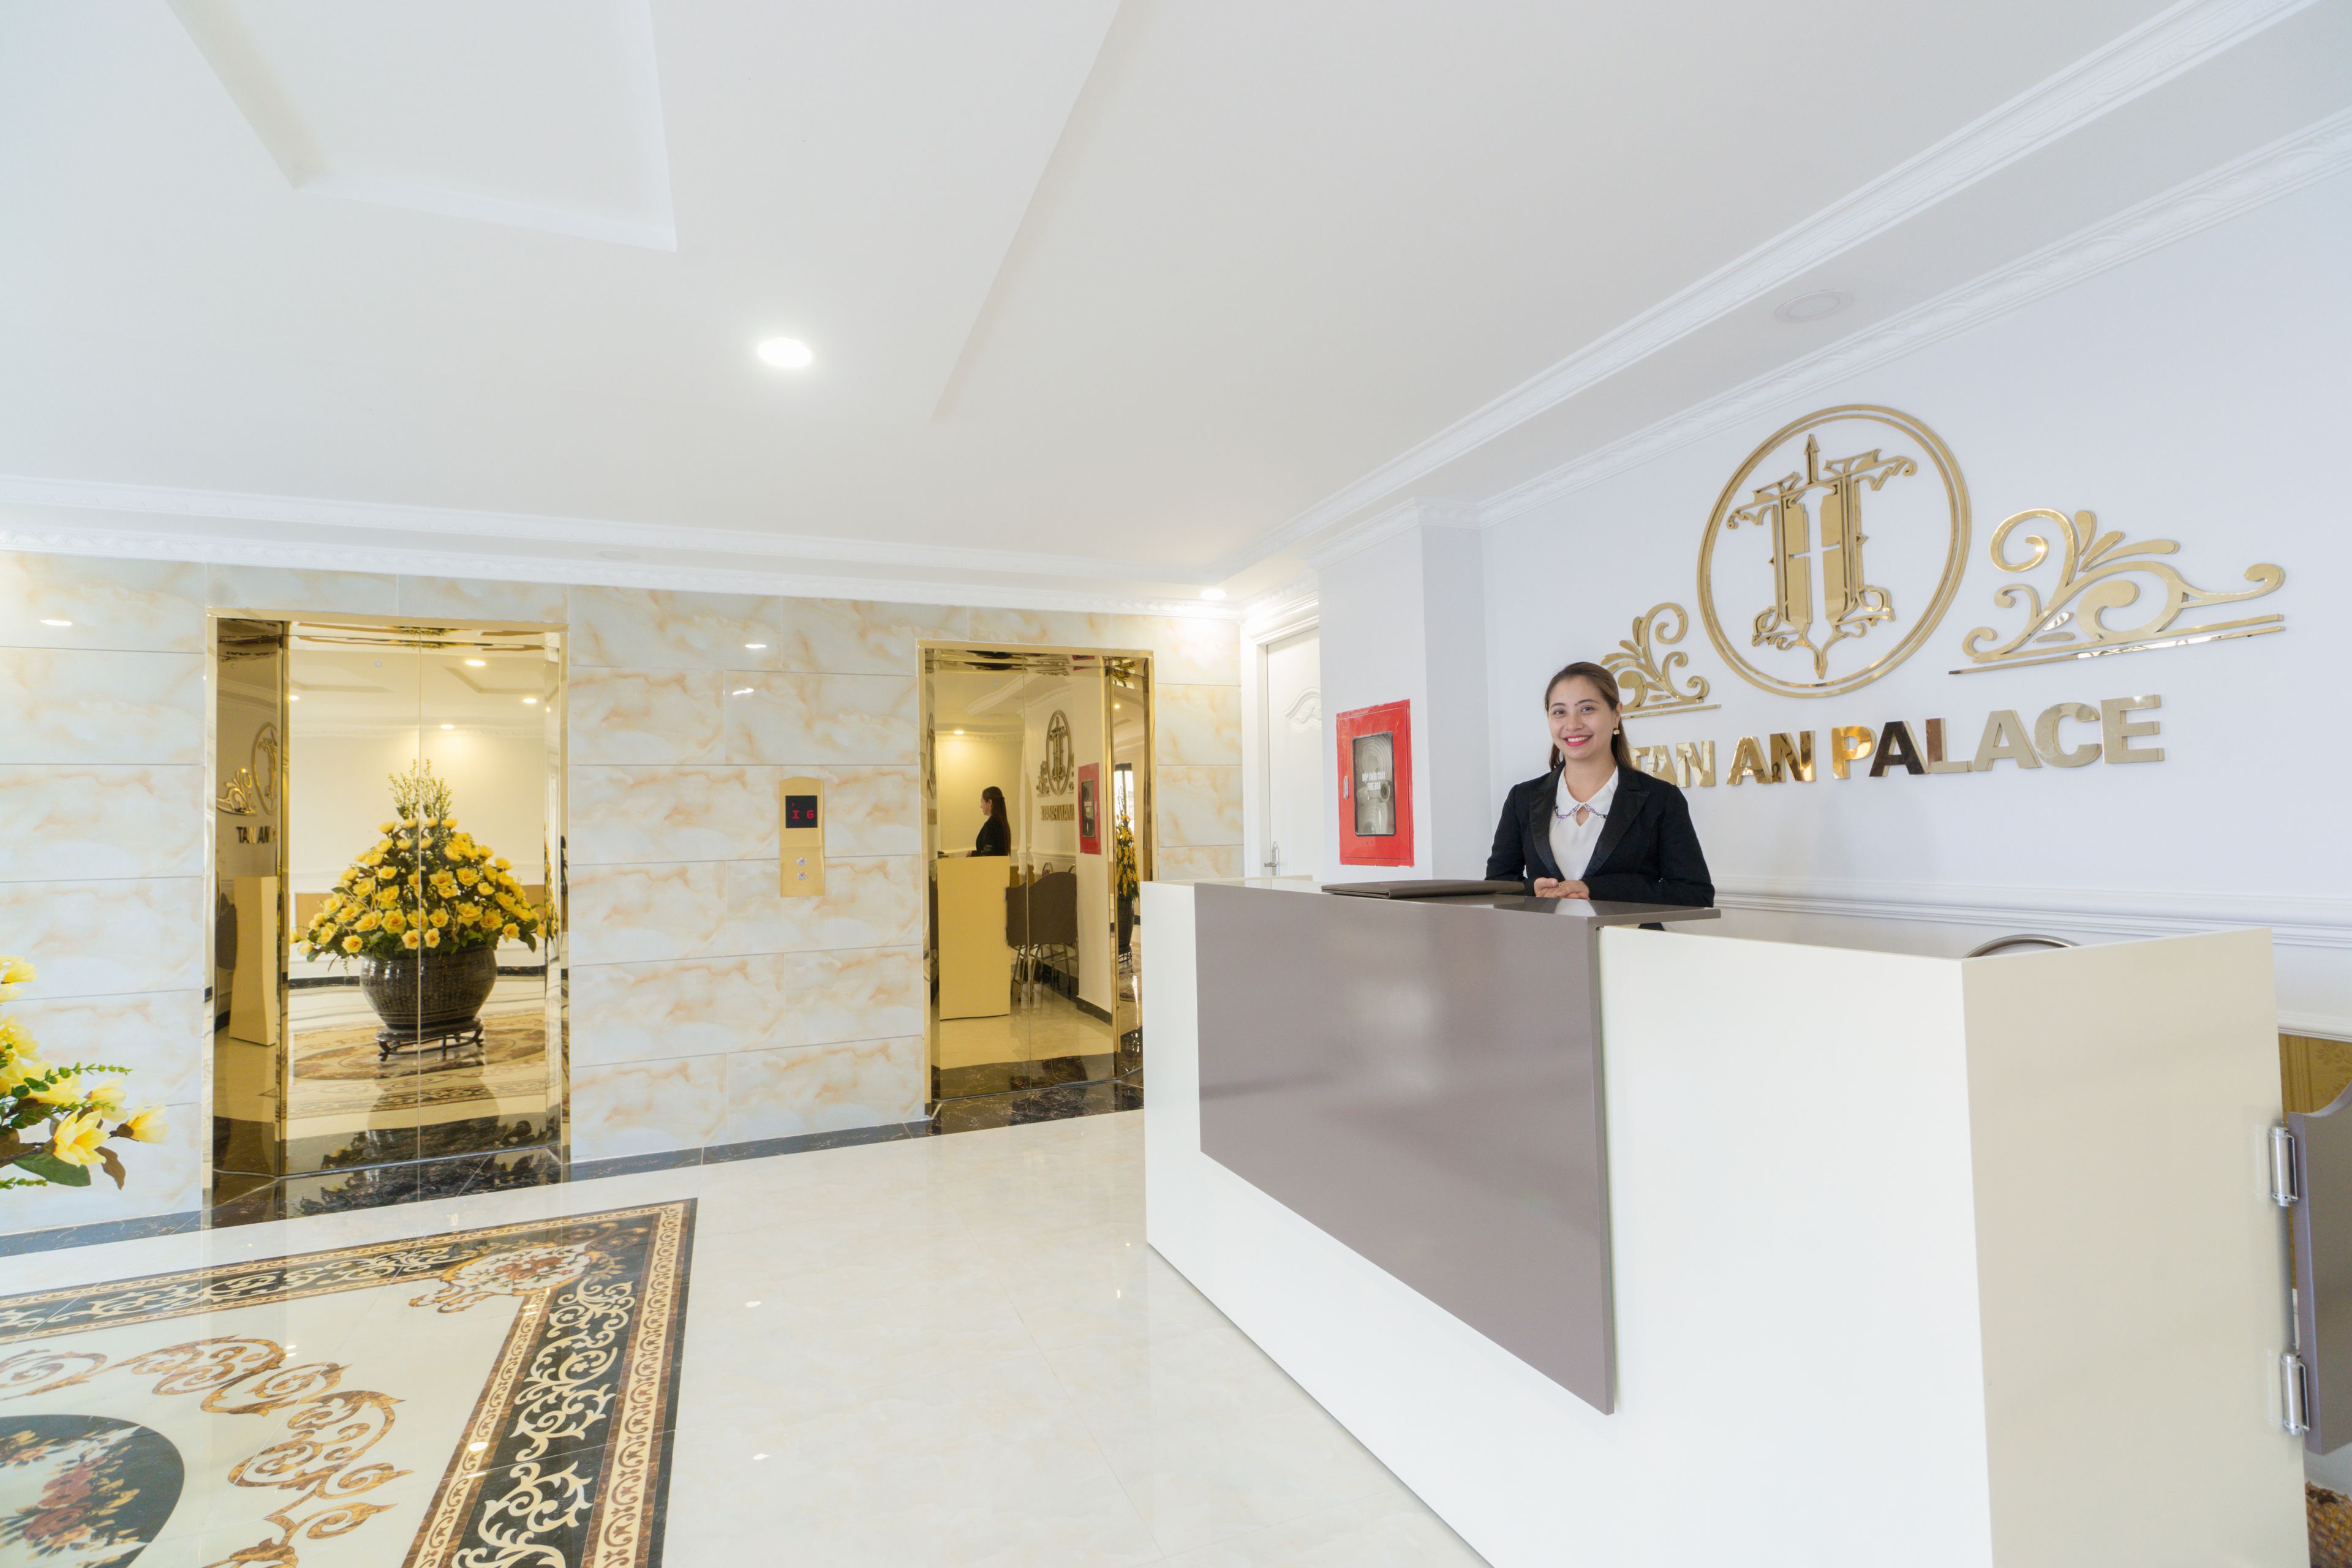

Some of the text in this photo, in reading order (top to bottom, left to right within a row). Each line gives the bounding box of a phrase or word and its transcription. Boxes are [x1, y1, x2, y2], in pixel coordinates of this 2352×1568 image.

[1630, 694, 2165, 788] TAN AN PALACE
[236, 826, 255, 843] TAN
